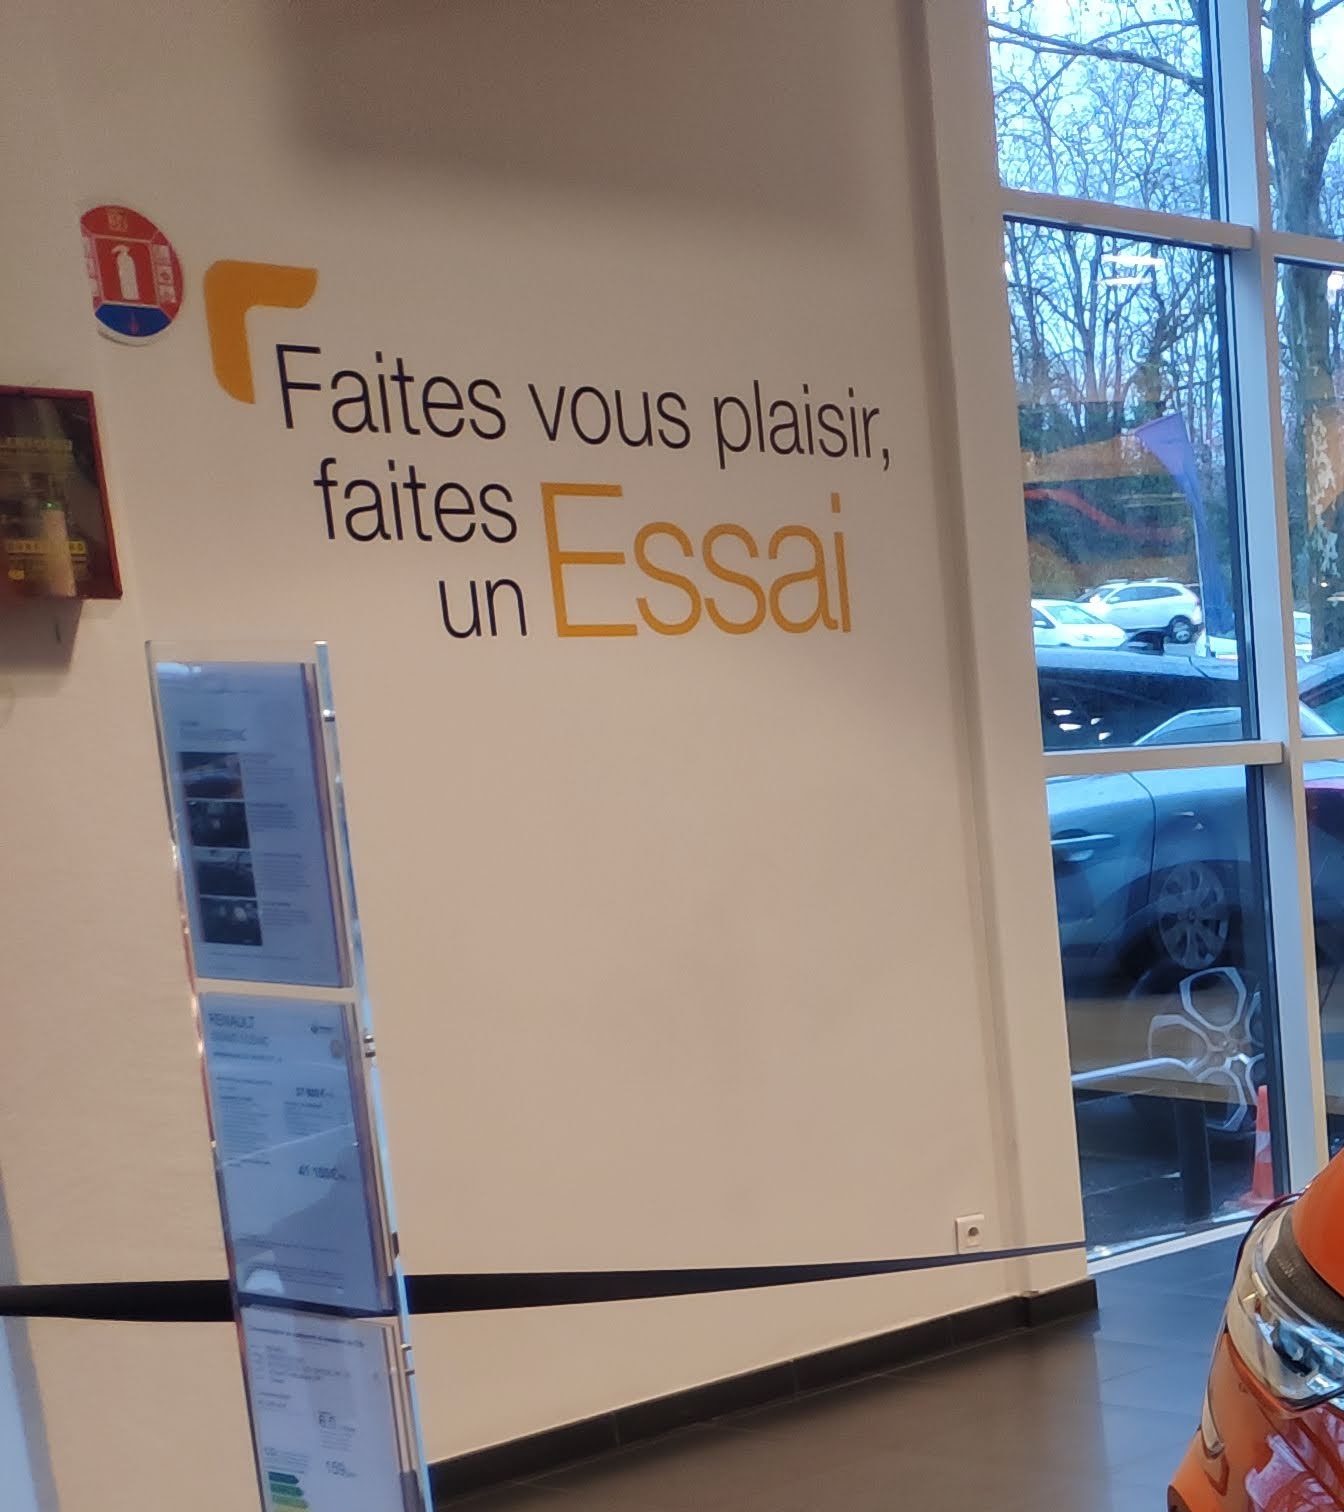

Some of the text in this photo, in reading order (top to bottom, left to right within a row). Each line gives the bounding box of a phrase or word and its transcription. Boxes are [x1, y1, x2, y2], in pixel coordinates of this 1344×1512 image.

[275, 343, 892, 472] Faites vous plaisir,
[313, 457, 518, 543] faites
[438, 481, 852, 639] un Essai
